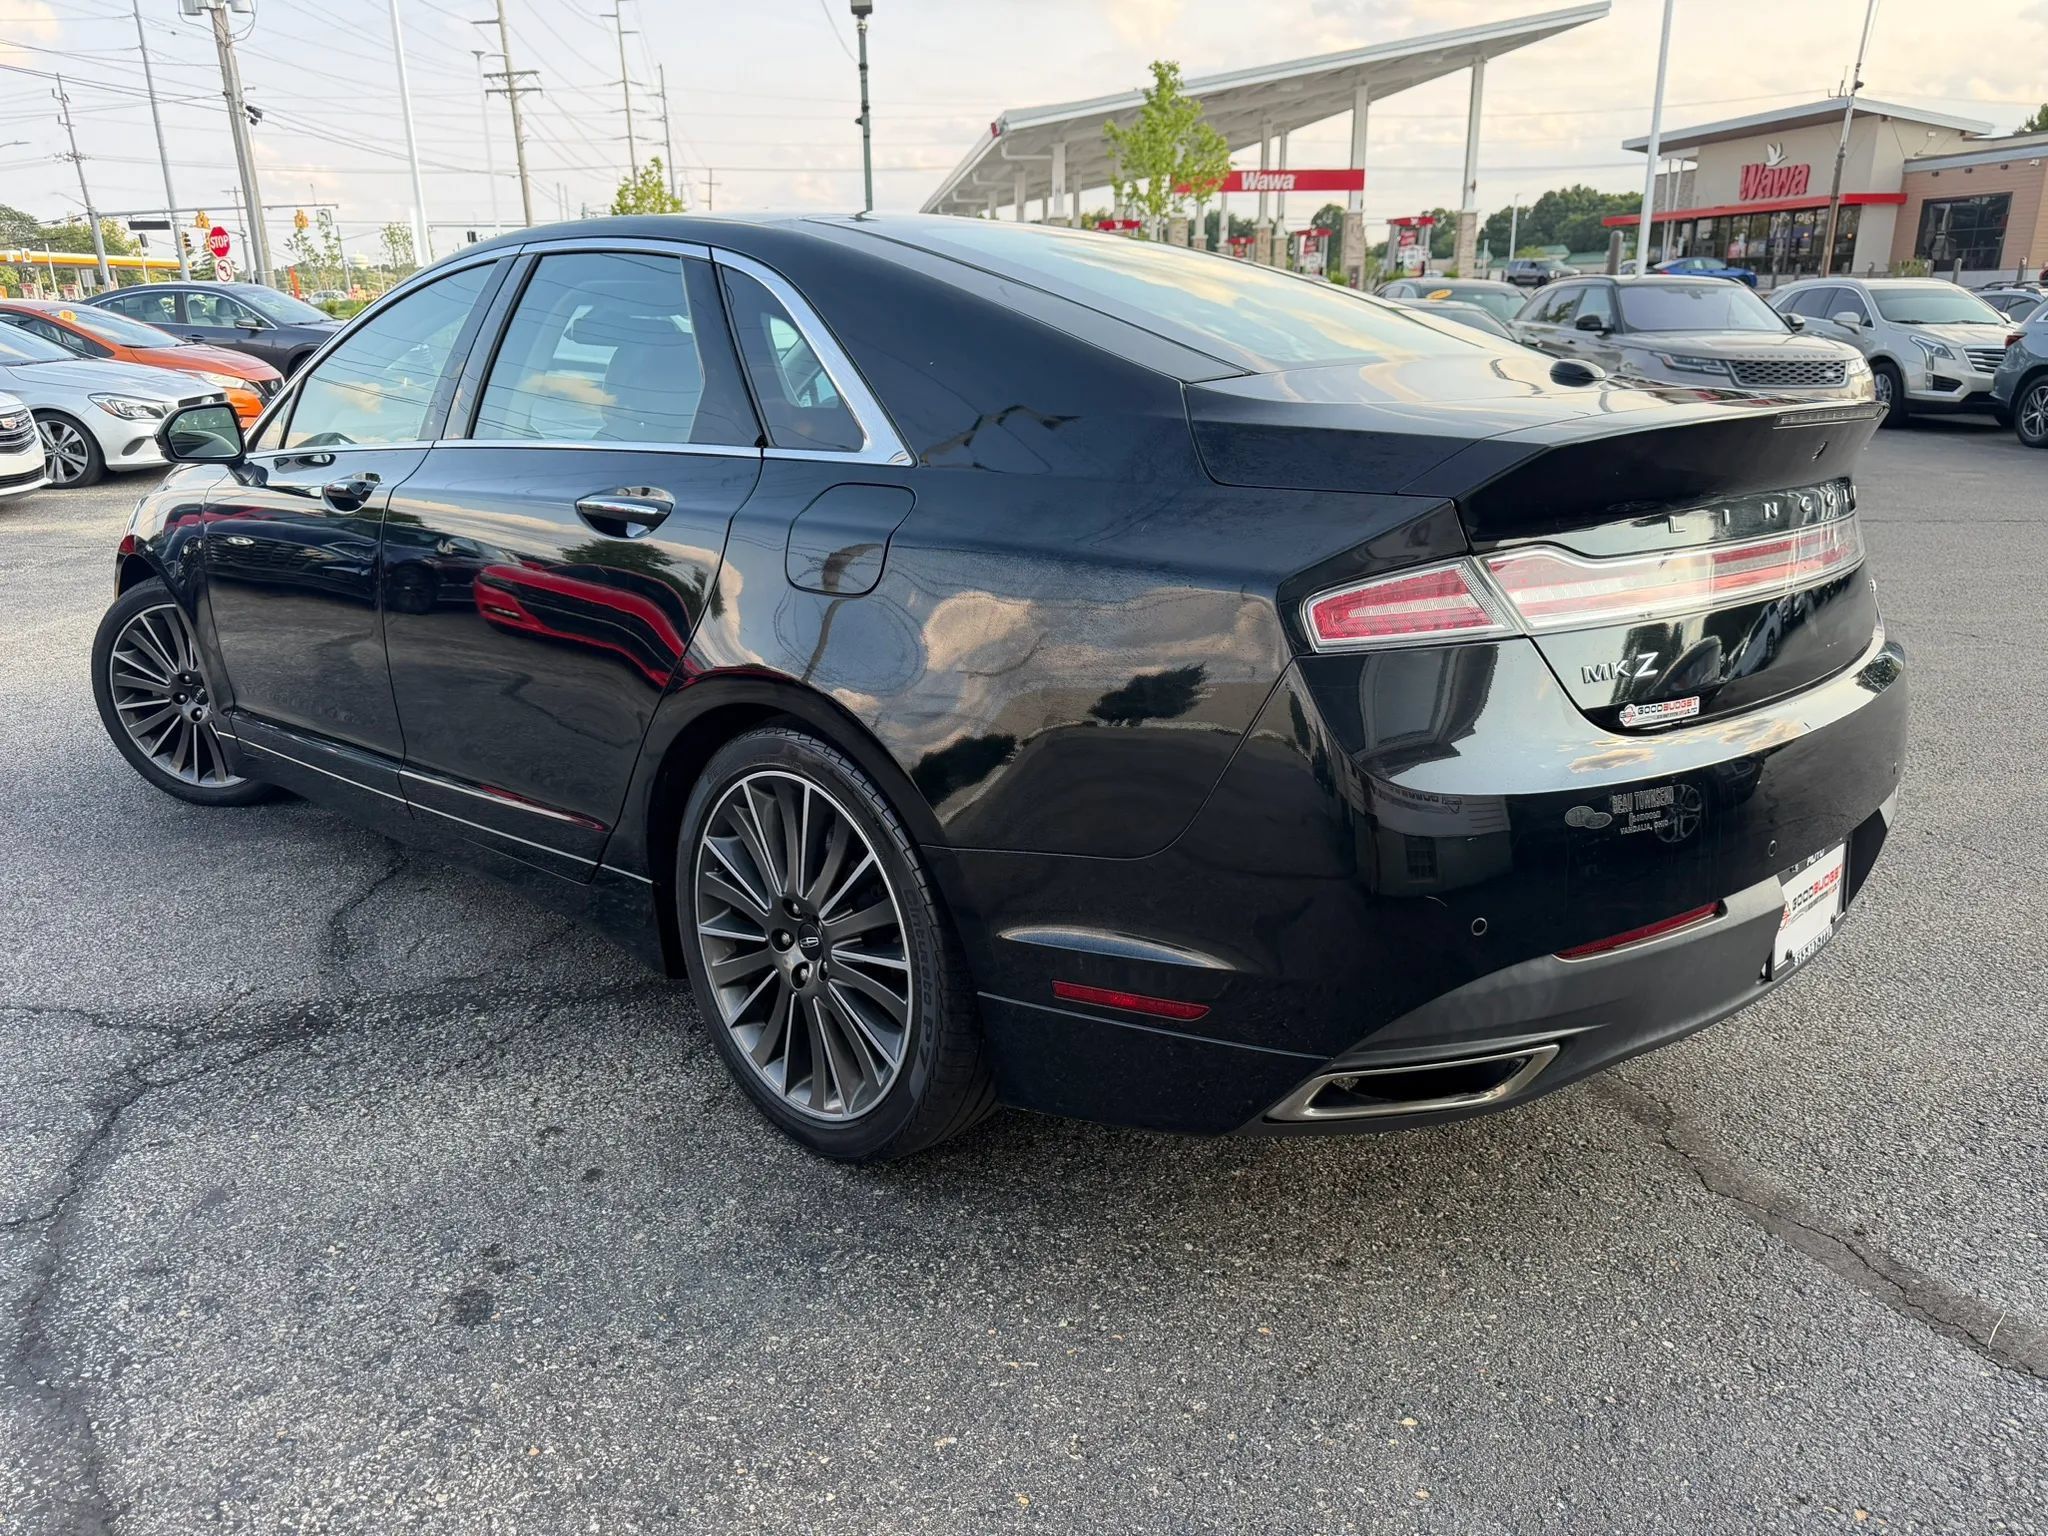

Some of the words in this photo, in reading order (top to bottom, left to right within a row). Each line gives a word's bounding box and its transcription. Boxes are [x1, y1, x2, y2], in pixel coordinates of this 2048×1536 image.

[1241, 171, 1296, 191] Wawa
[1740, 163, 1810, 201] Wawa
[211, 235, 229, 249] STOP
[1637, 697, 1699, 716] GOODBUDGET
[1634, 785, 1675, 811] TOWNSEND
